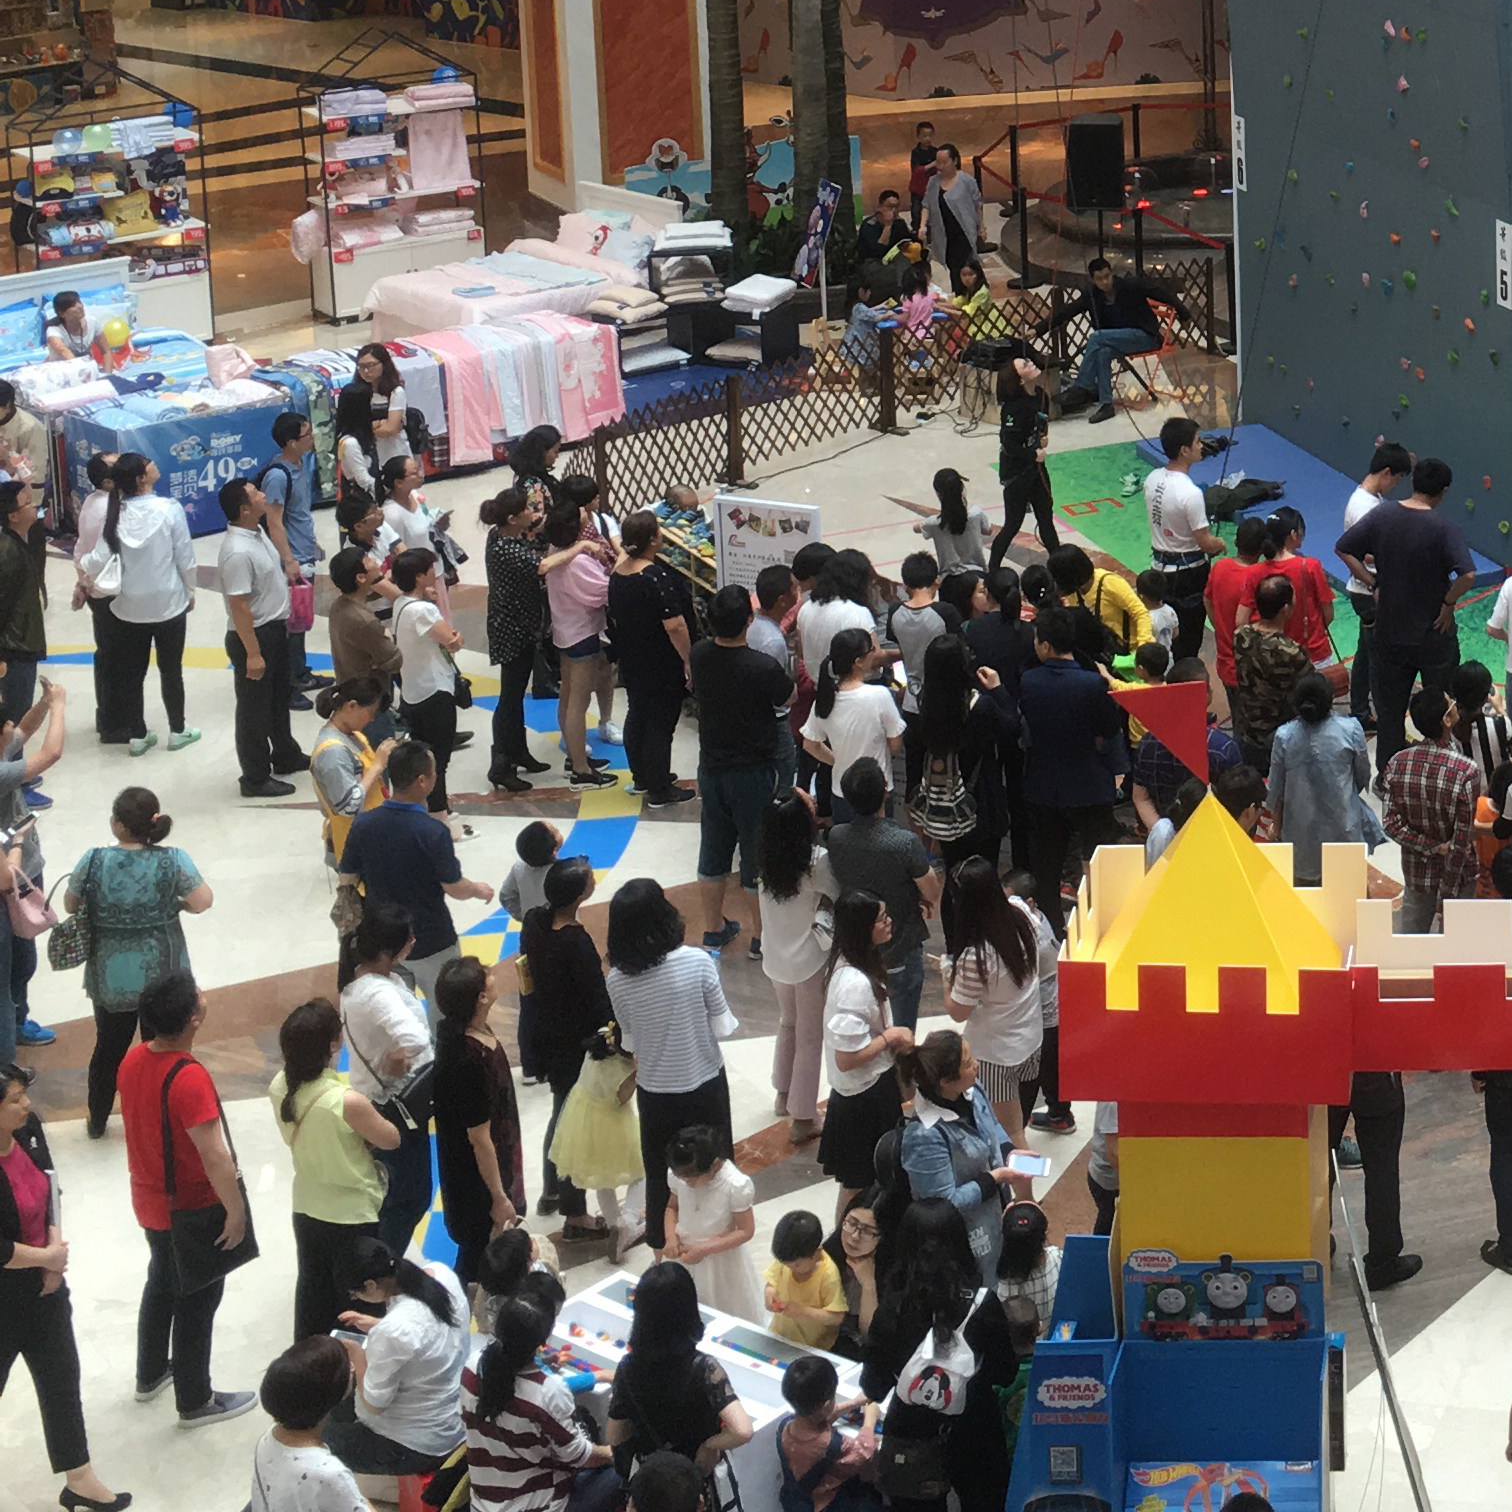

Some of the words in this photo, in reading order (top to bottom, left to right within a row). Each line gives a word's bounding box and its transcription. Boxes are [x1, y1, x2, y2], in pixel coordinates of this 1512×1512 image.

[1237, 157, 1243, 185] 6
[1500, 269, 1508, 301] 5
[198, 456, 236, 492] 49
[1134, 1255, 1173, 1263] THOMAS
[1044, 1383, 1100, 1394] THOMAS
[1057, 1393, 1096, 1402] FRIENDS
